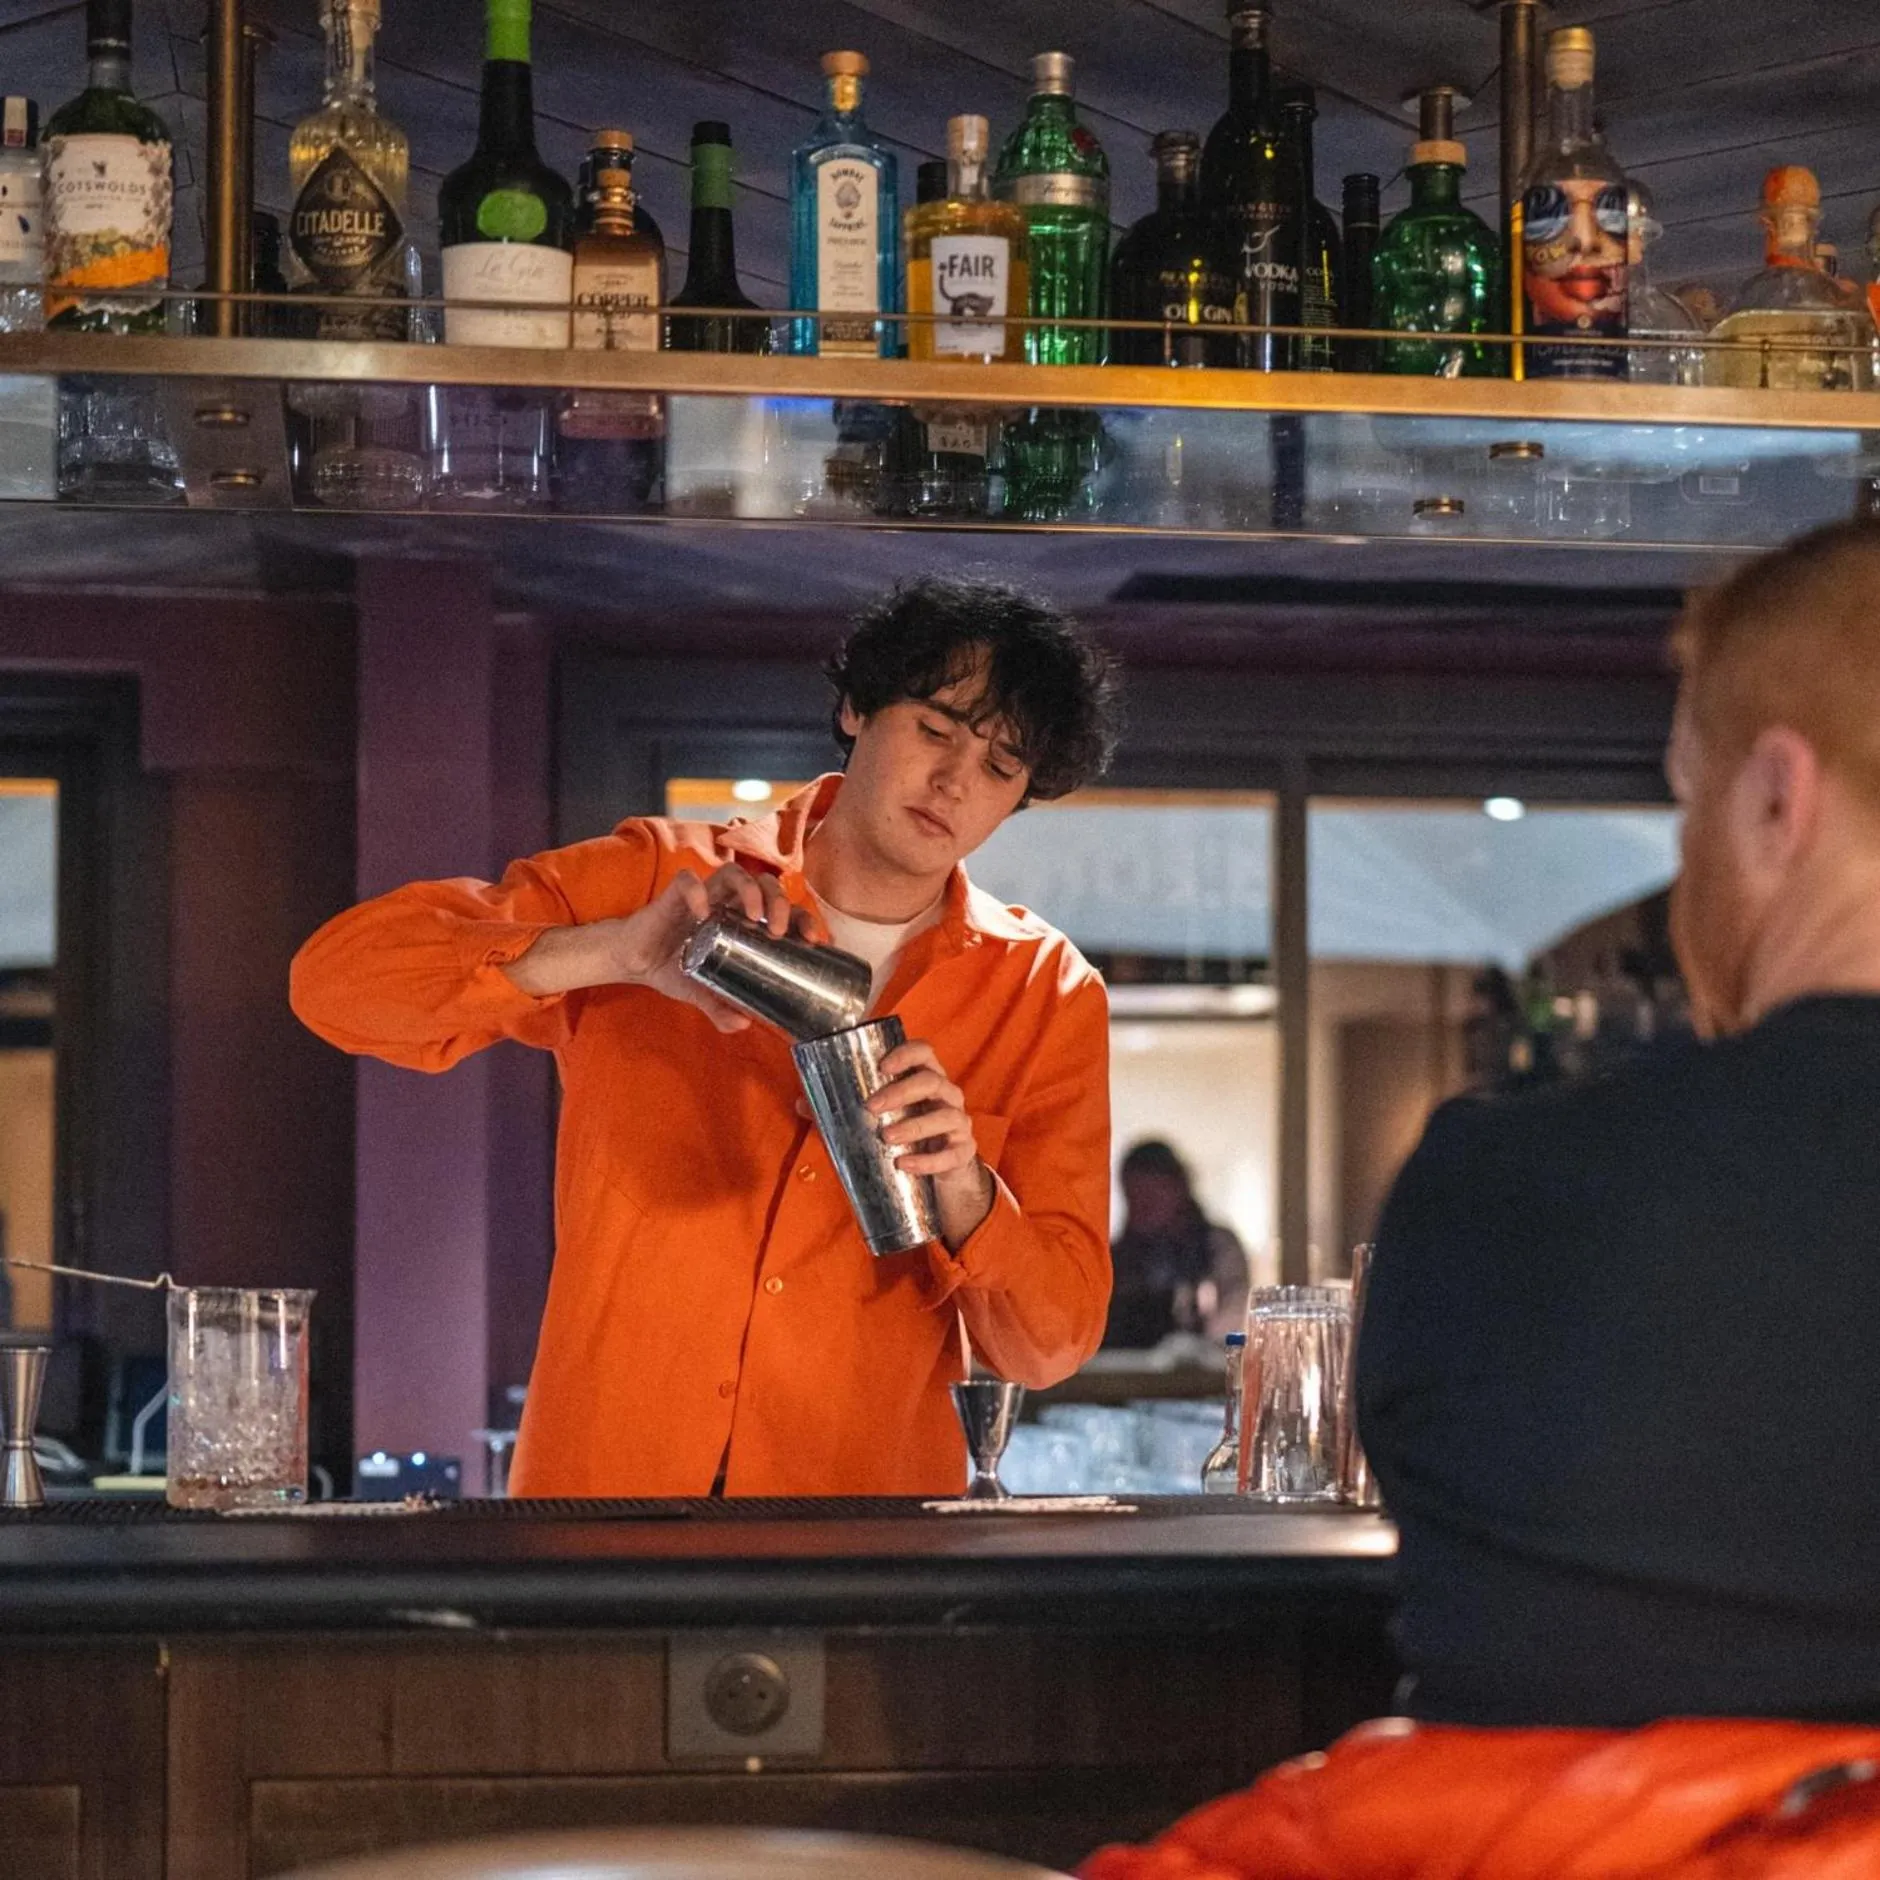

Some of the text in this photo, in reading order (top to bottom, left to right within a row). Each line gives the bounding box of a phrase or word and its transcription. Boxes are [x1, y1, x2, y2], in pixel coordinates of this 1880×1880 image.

[57, 180, 146, 196] COTSWOLDS
[297, 210, 385, 237] CITADELLE
[948, 253, 994, 278] FAIR
[1245, 263, 1298, 282] VODKA
